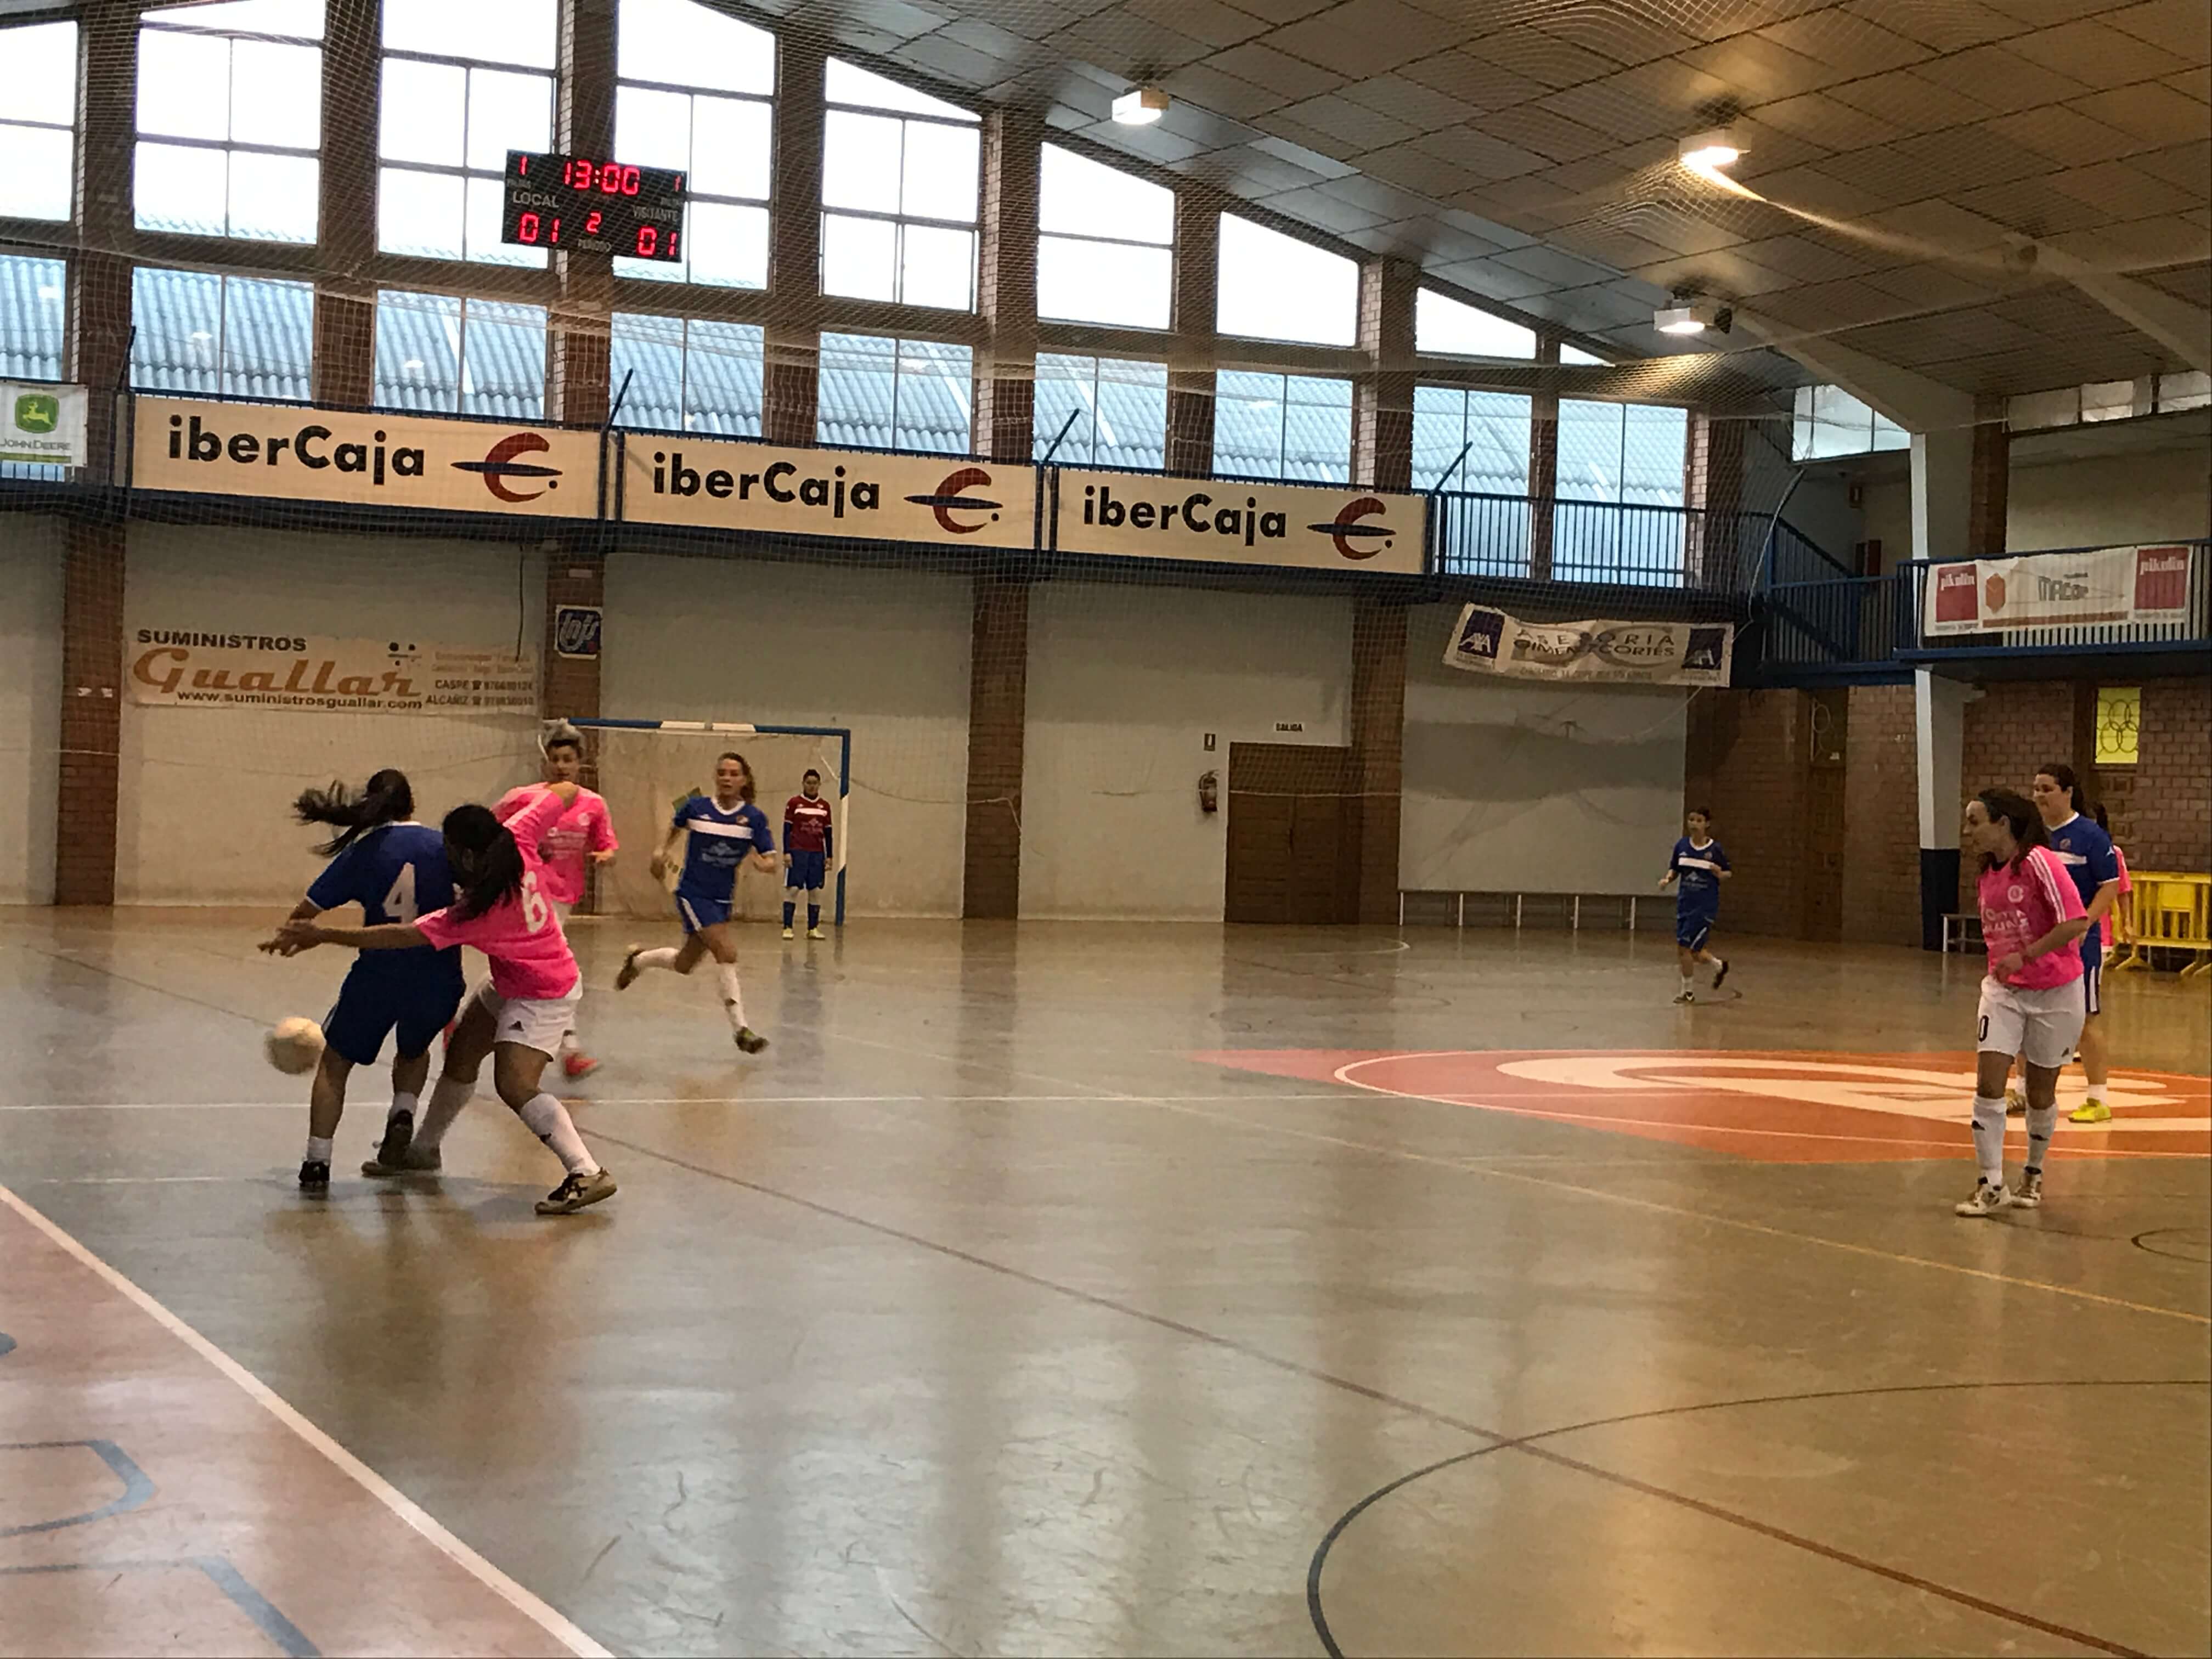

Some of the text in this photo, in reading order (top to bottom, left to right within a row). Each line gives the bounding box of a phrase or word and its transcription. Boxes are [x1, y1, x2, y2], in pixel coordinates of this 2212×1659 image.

[563, 159, 641, 195] 13:00
[513, 191, 560, 208] LOCAL
[586, 210, 602, 234] 2
[0, 438, 71, 450] JOHN DEERE
[170, 415, 424, 485] iberCaja
[654, 452, 879, 518] iberCaja
[1084, 486, 1286, 546] iberCaja
[138, 629, 306, 651] SUMINISTROS
[133, 647, 422, 697] Guallar
[435, 680, 469, 690] CASPE
[177, 692, 422, 709] www.suministrosguallar.com
[383, 862, 418, 924] 4
